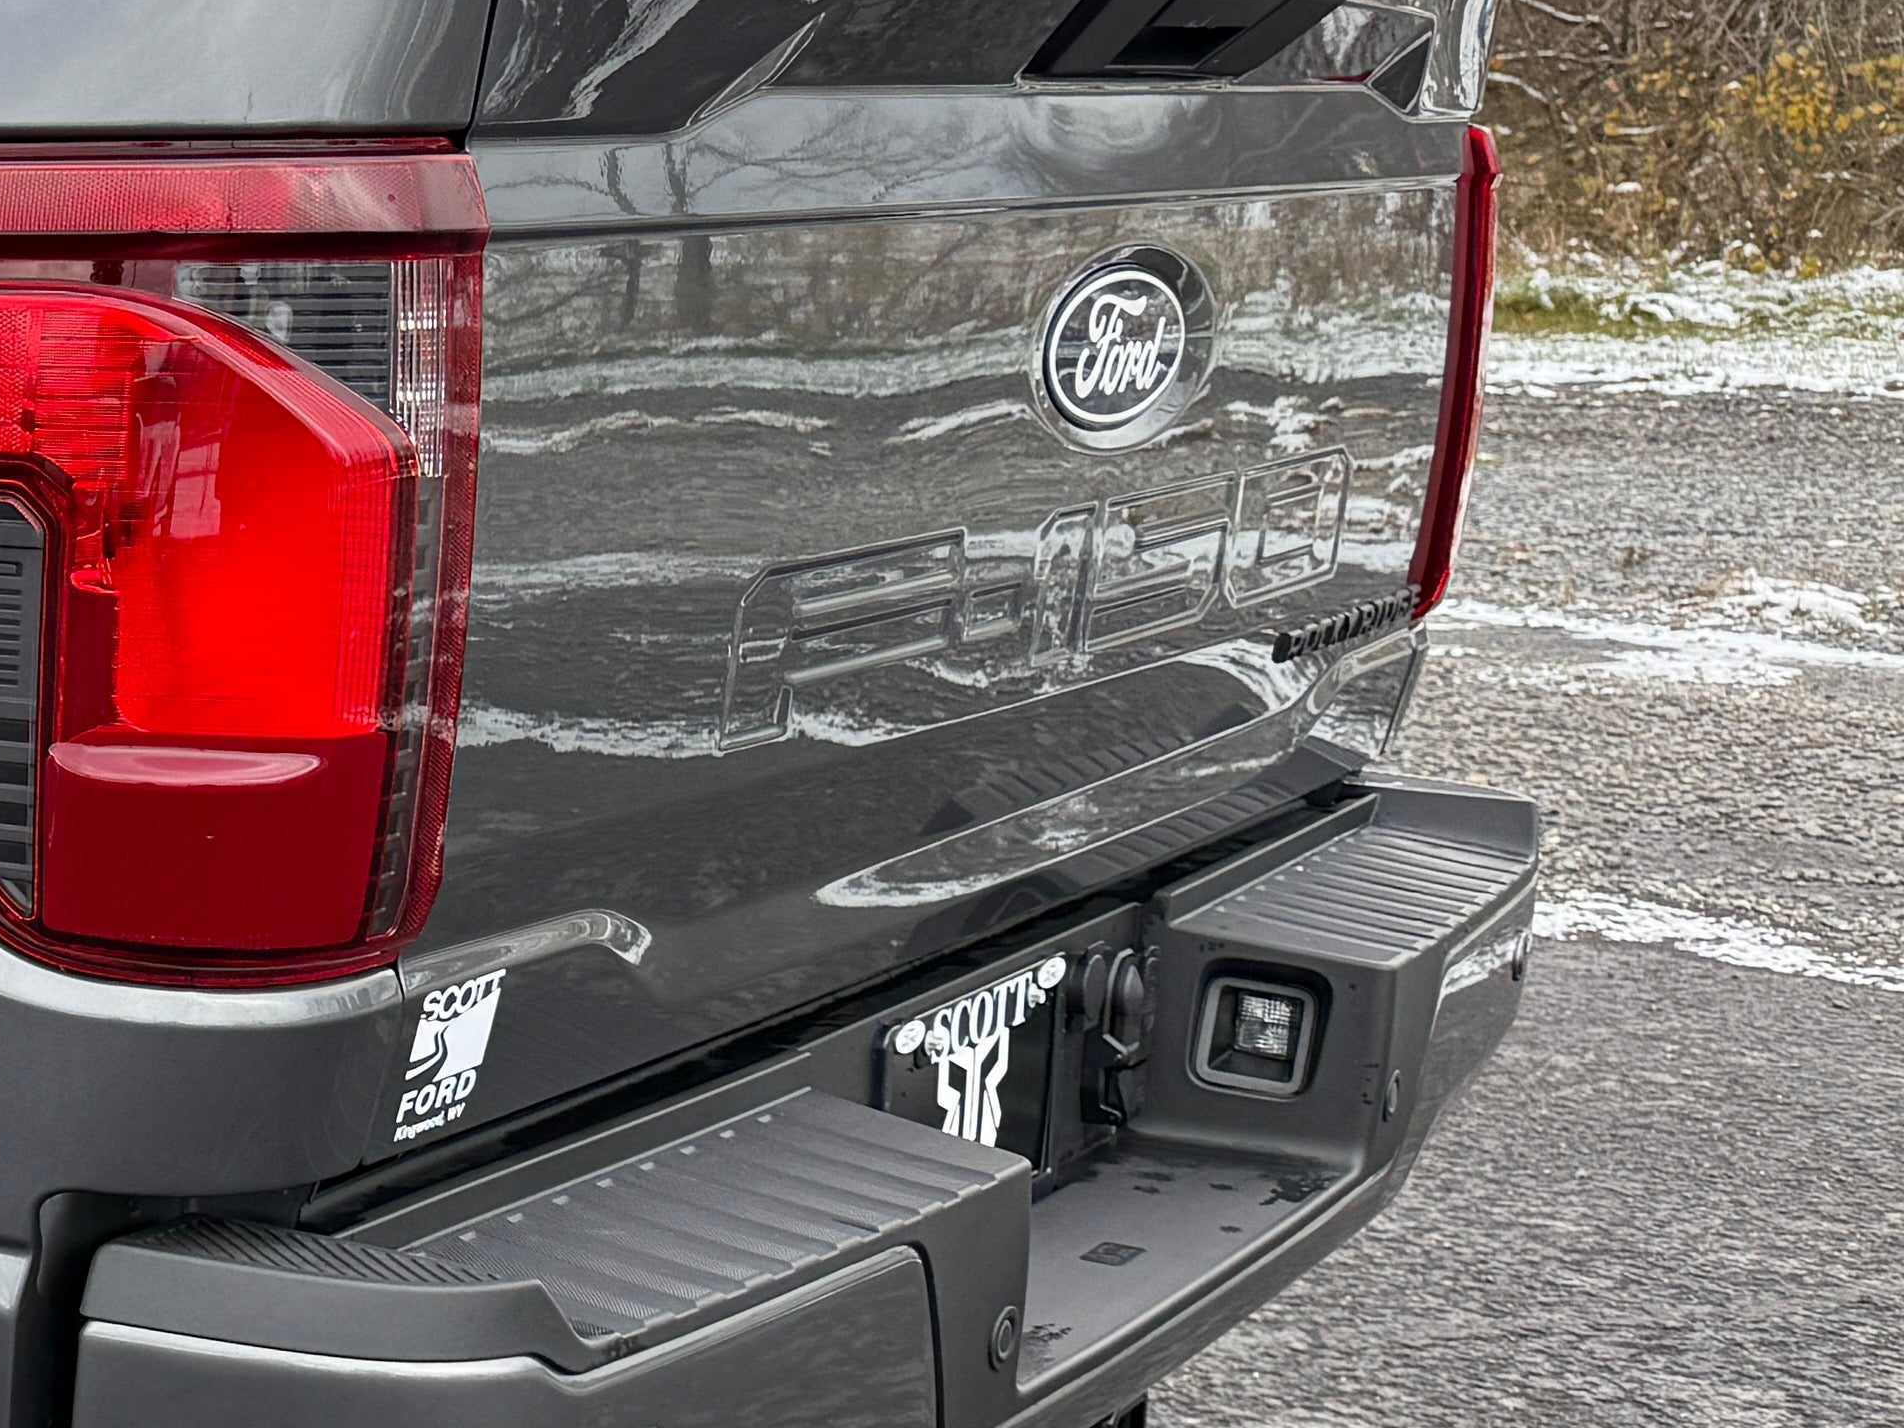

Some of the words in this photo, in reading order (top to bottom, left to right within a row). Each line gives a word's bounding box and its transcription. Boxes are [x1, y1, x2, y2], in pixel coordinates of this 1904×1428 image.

[1075, 294, 1168, 399] Ford
[716, 445, 1354, 756] F-150
[420, 968, 507, 1022] SCOTT
[930, 970, 1034, 1065] SCOTT
[395, 1068, 477, 1124] FORD
